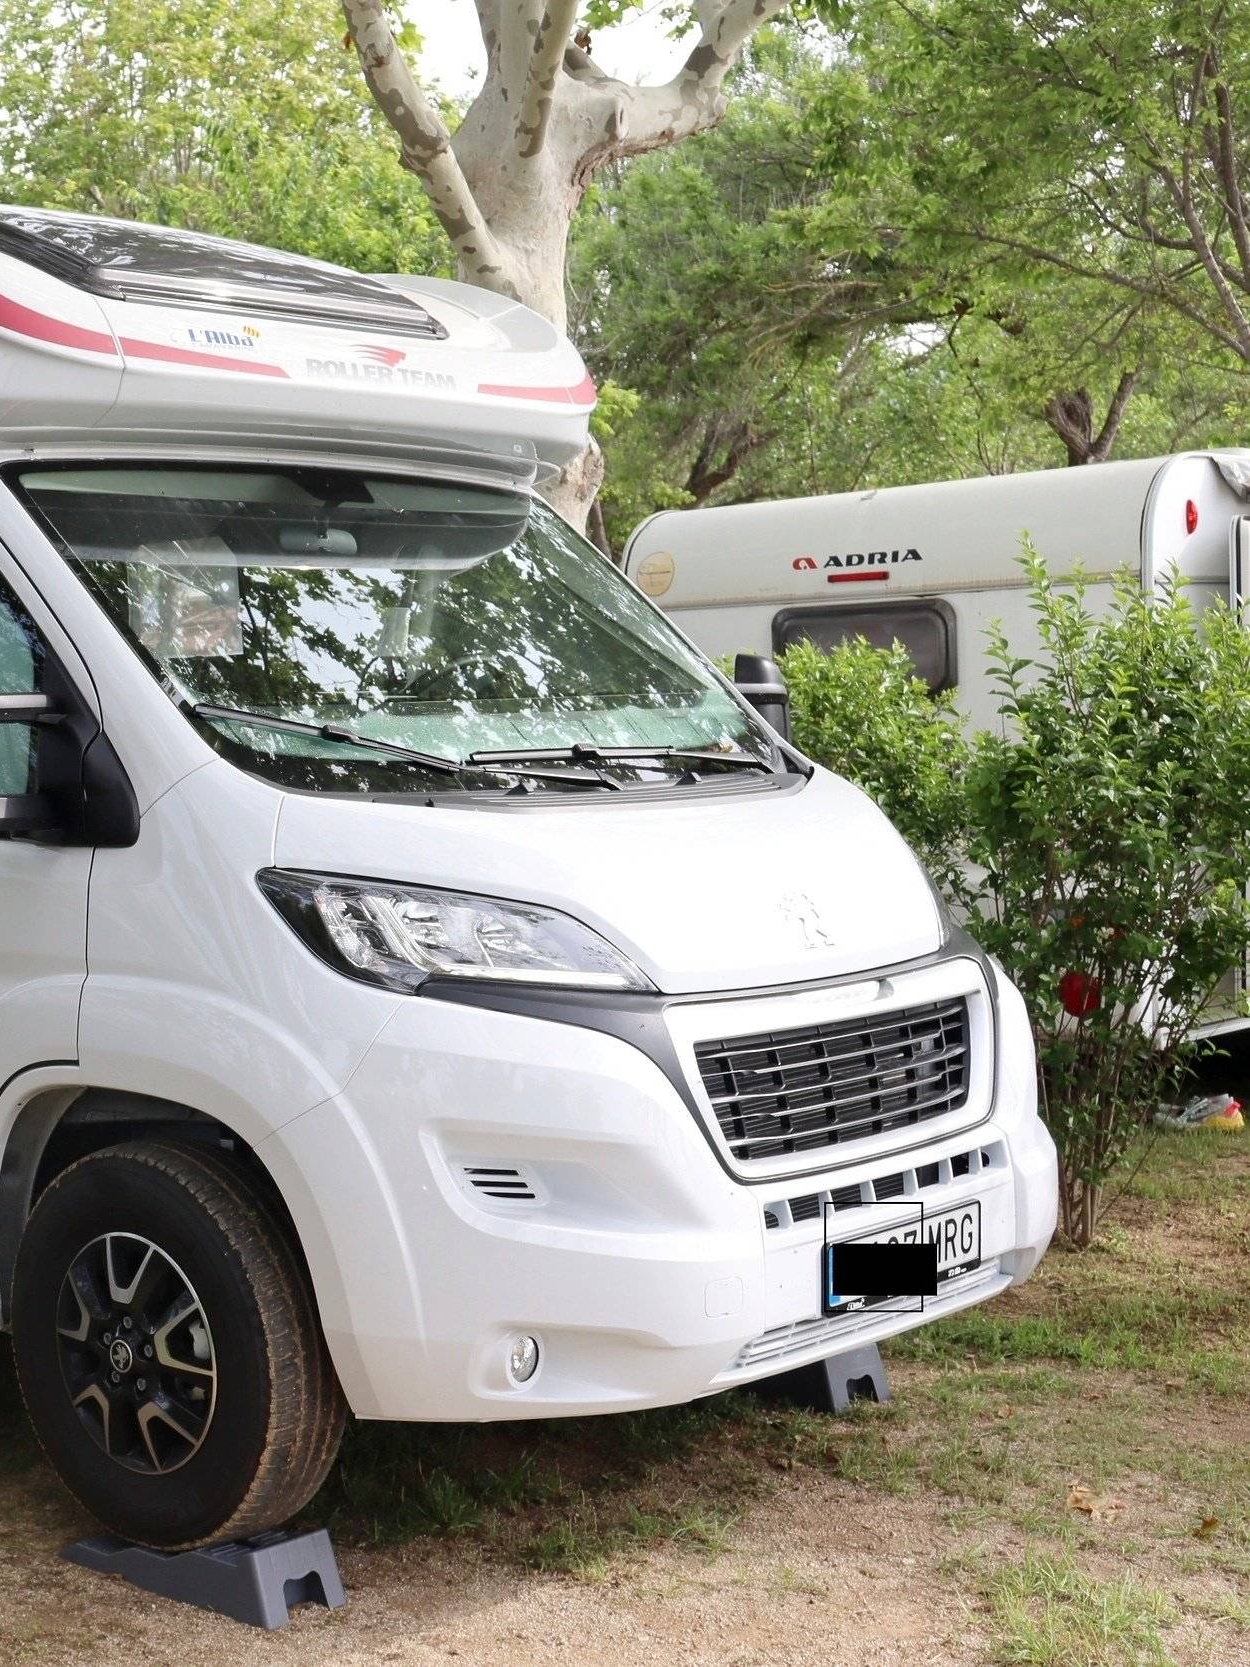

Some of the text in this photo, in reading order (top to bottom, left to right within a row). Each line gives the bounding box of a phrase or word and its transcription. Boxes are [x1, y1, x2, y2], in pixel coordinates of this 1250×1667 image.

[305, 357, 456, 392] ROLLER TEAM
[823, 548, 923, 569] ADRIA
[928, 1212, 973, 1264] MRG
